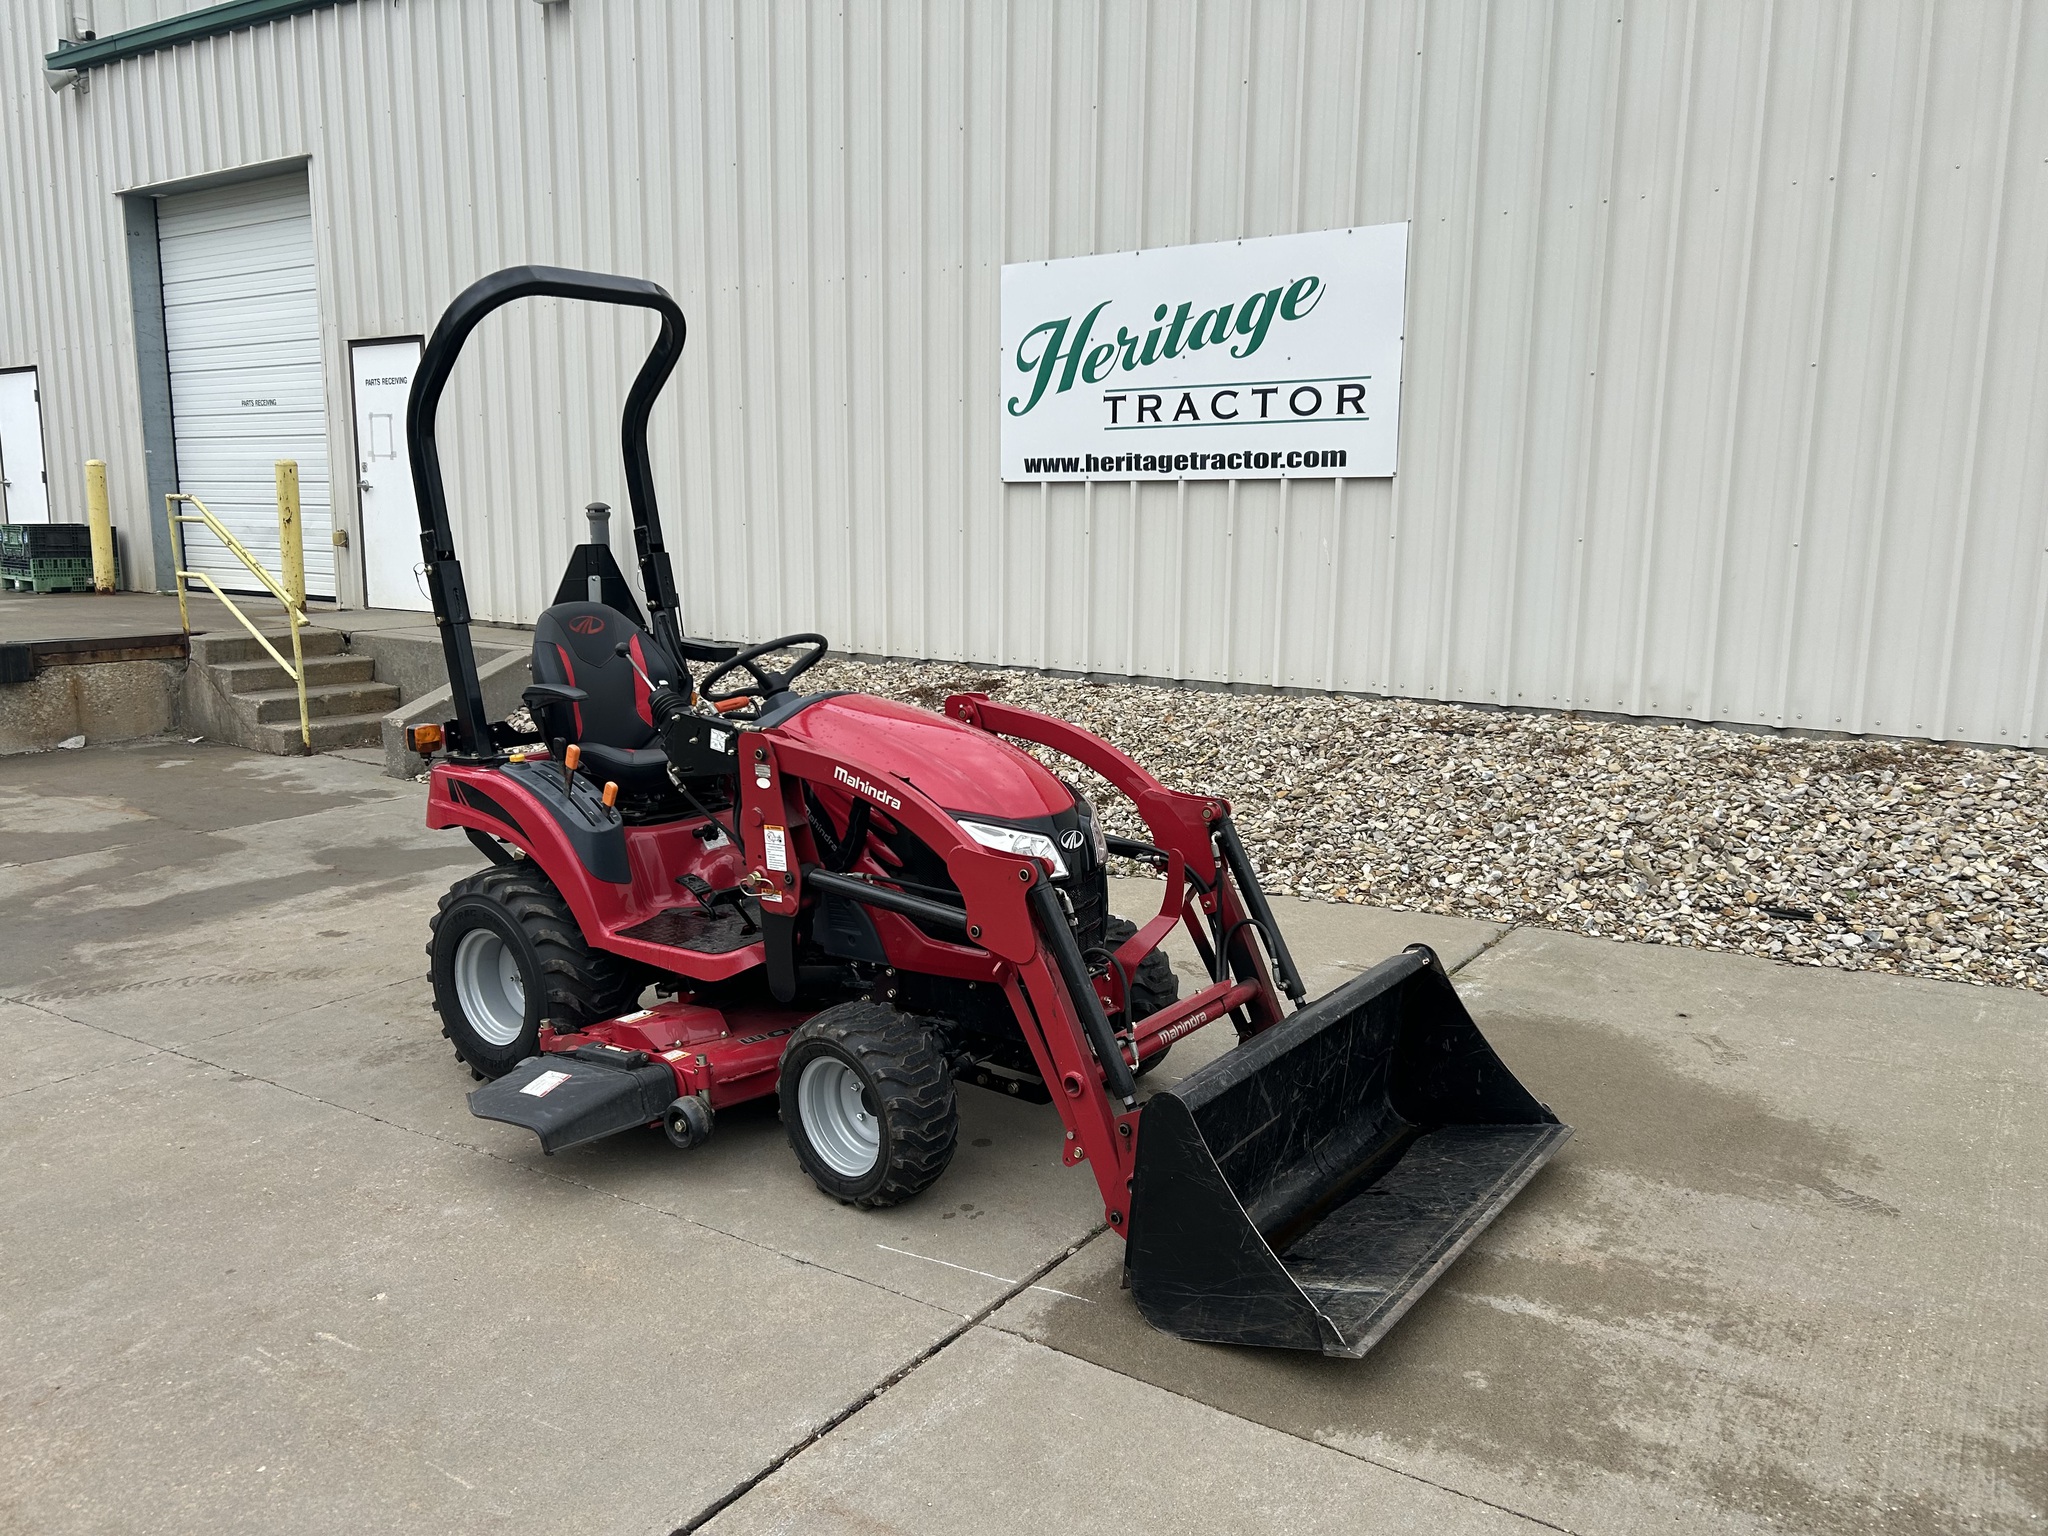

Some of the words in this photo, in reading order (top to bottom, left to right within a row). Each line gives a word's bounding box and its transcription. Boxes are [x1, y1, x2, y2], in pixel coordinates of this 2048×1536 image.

[1007, 275, 1327, 416] Heritage
[365, 378, 381, 386] PARTS
[382, 376, 408, 385] RECEIVING
[241, 399, 255, 407] PARTS
[255, 398, 277, 407] RECEIVING
[1103, 383, 1367, 424] TRACTOR
[1023, 449, 1348, 474] www.heritagetractor.com
[834, 765, 902, 811] Mahindra
[1158, 1011, 1208, 1046] Mahindra
